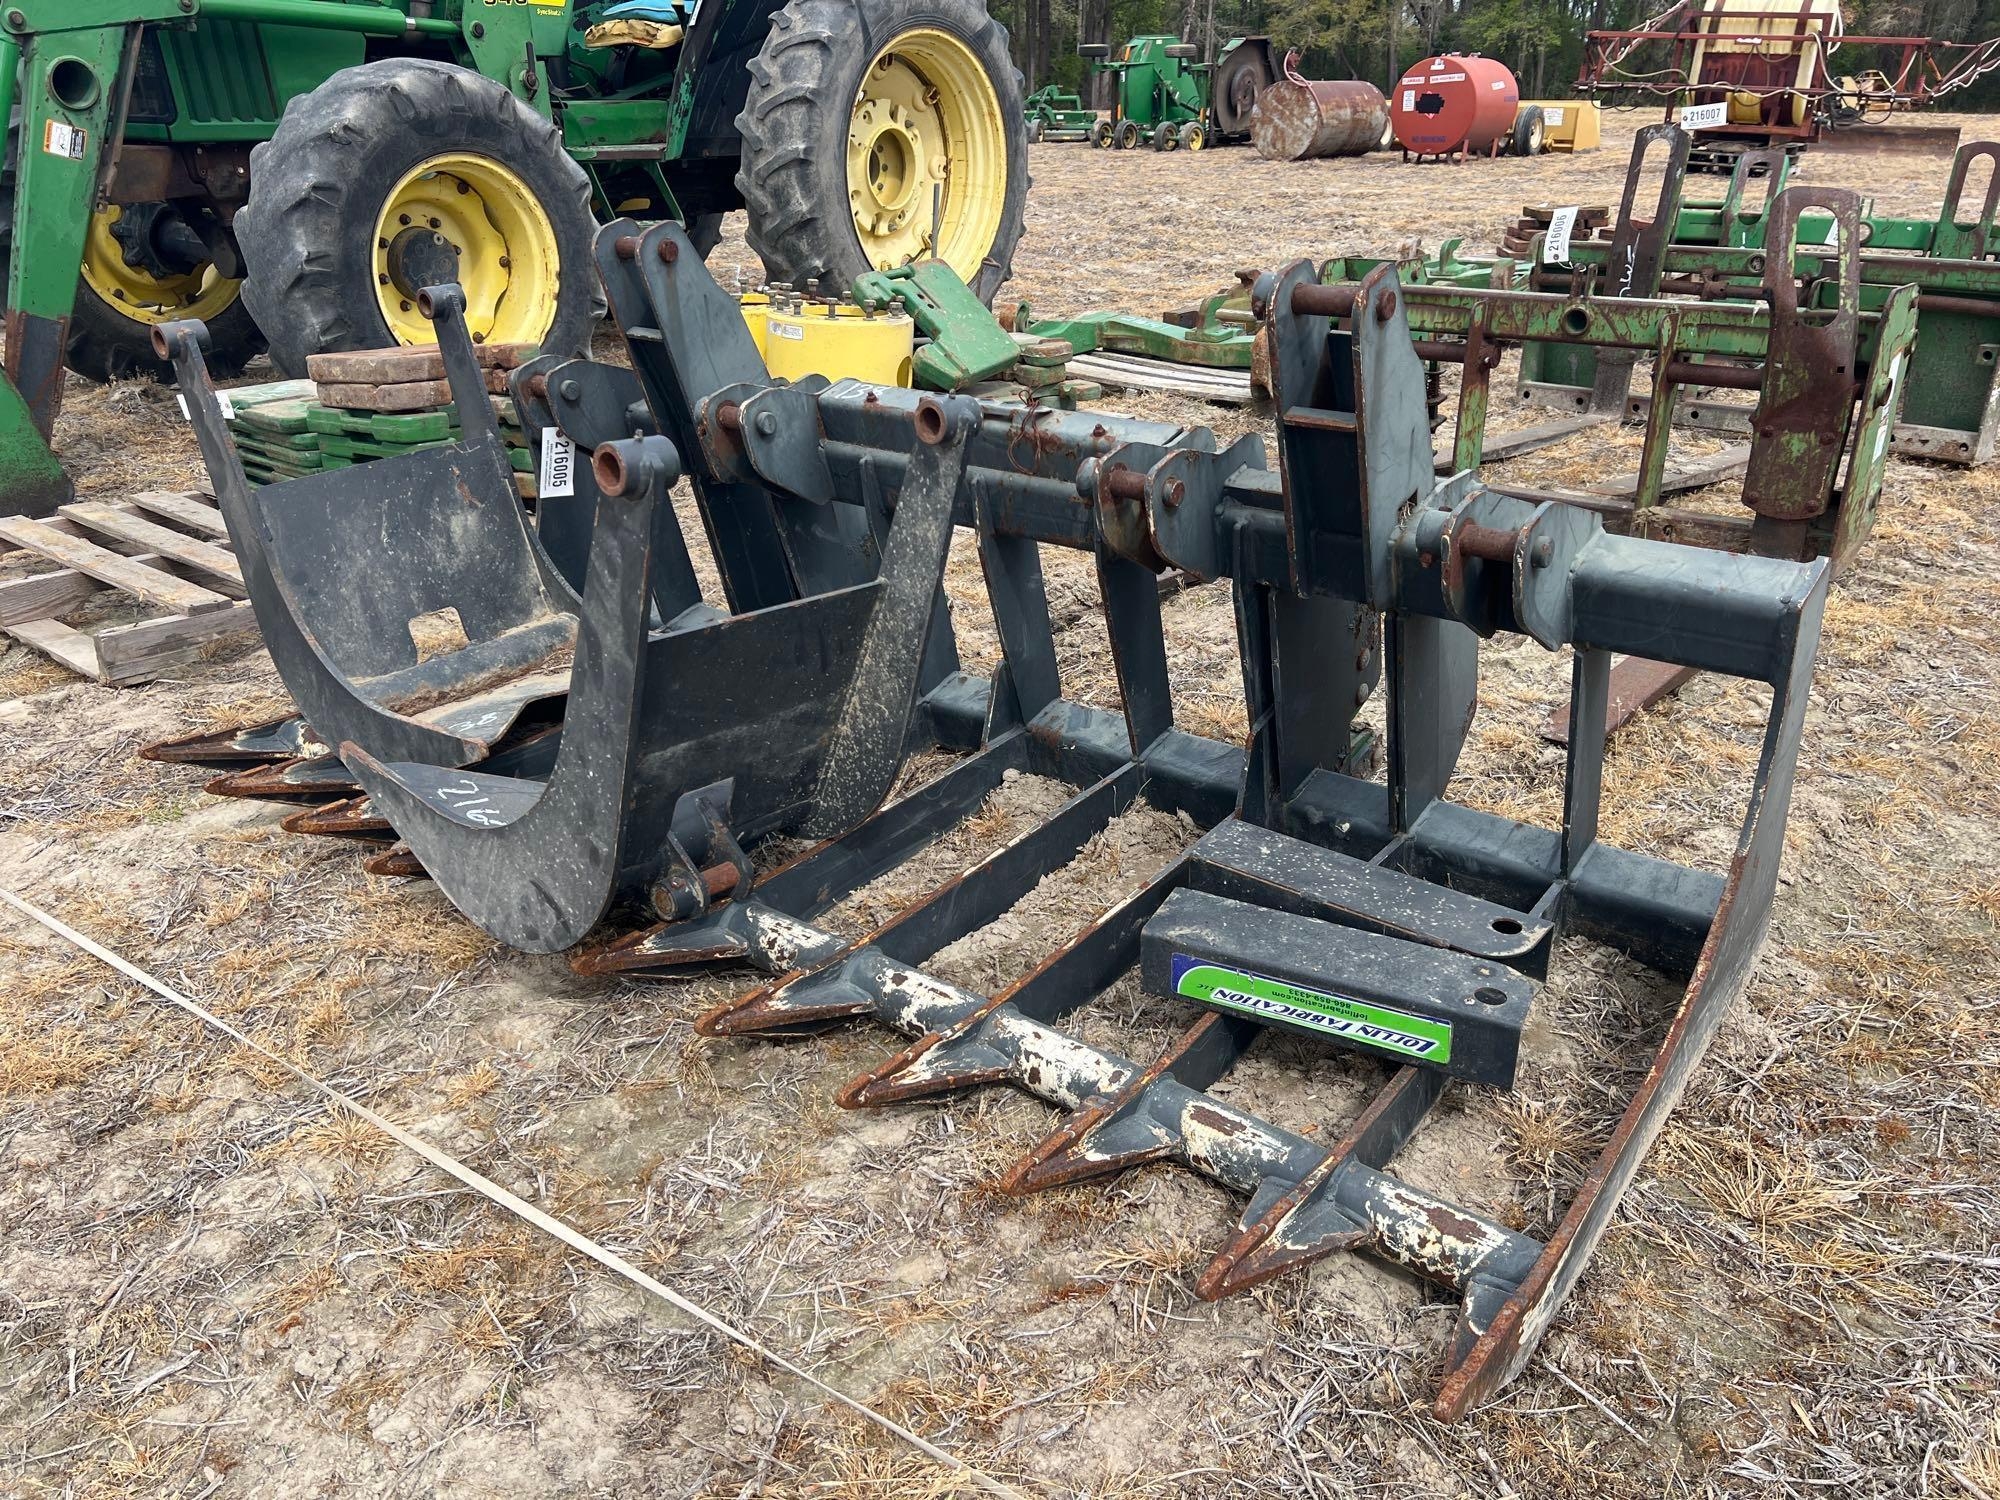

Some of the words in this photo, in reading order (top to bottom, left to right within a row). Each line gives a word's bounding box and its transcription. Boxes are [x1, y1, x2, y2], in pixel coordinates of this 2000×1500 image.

[1690, 108, 1721, 121] 216007
[1548, 214, 1567, 252] 216006
[552, 440, 570, 488] 216005
[1196, 983, 1215, 992] LLC
[1288, 988, 1351, 1010] 866-859-4333
[1214, 988, 1353, 1032] FABRICATION
[1271, 991, 1368, 1021] loflinfabrication.com
